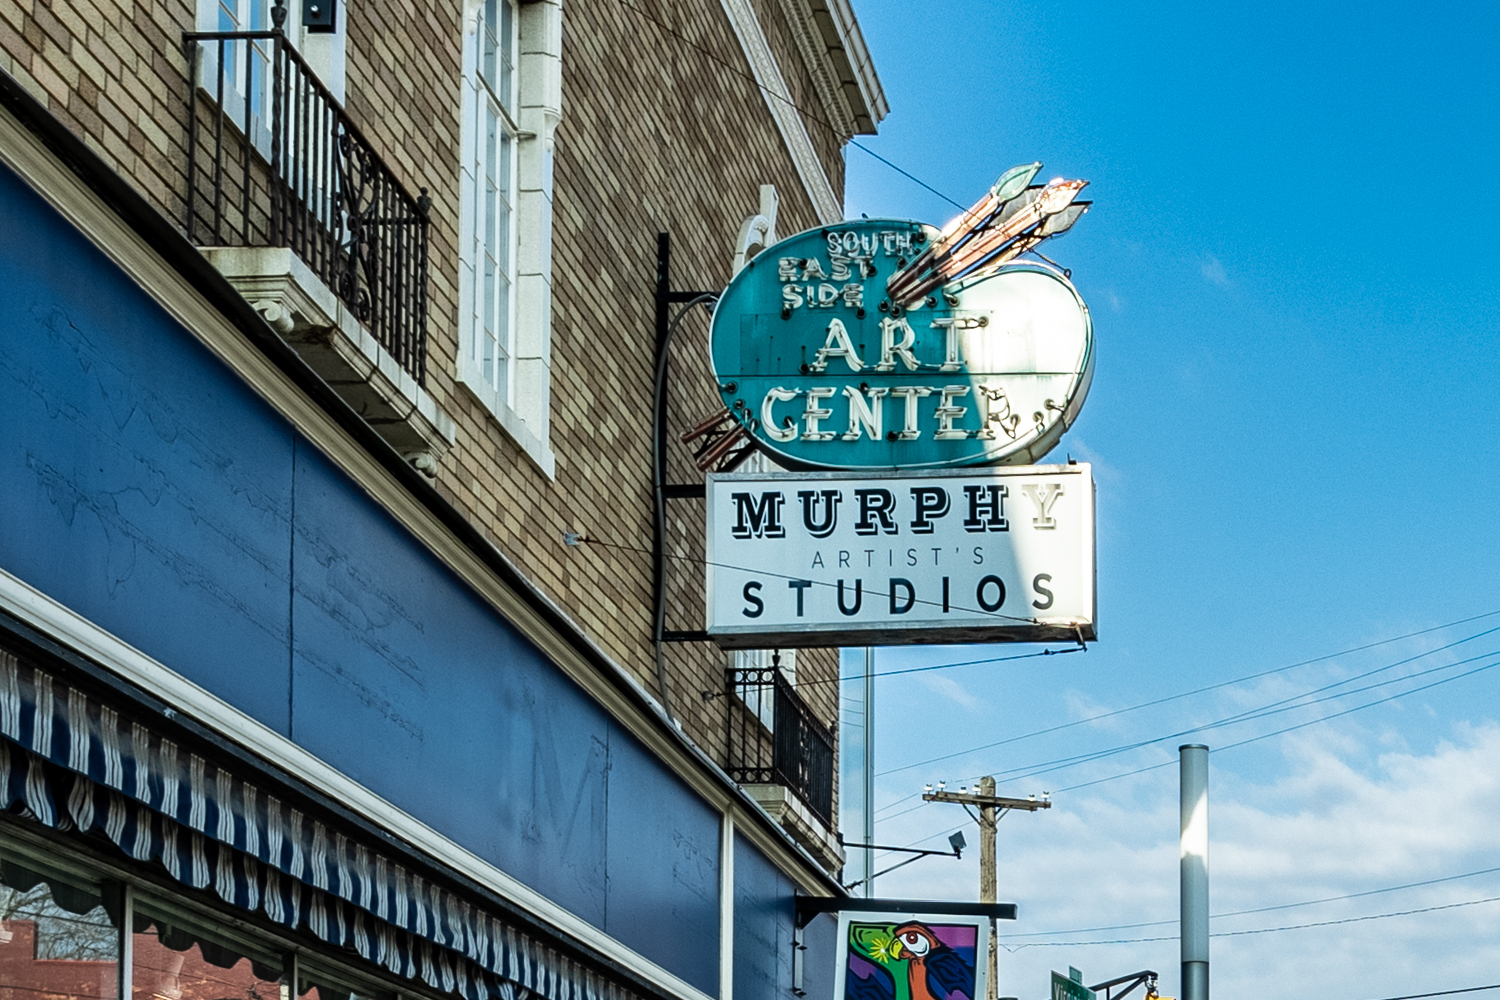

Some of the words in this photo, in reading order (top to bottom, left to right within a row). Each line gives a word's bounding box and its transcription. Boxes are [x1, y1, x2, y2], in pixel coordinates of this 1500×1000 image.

[826, 231, 914, 257] SOUTH
[778, 256, 874, 281] EAST
[781, 283, 865, 309] SIDE
[814, 318, 966, 373] ART
[761, 384, 1016, 443] CENTER
[731, 483, 1064, 539] MURPHY
[811, 546, 984, 569] ARTIST'S
[741, 573, 1054, 619] STUDIOS
